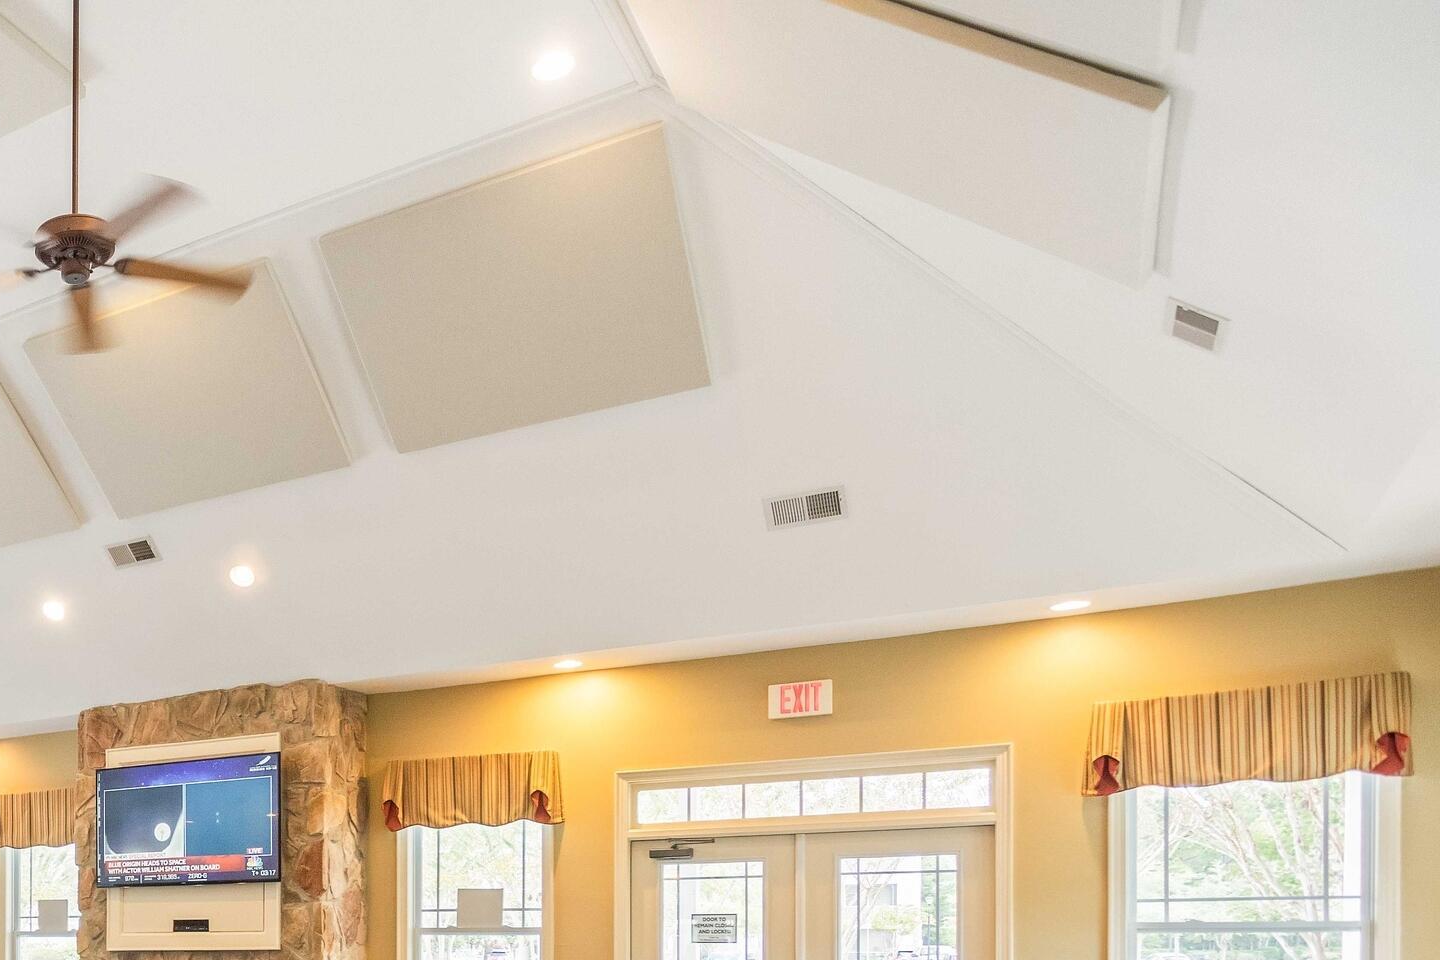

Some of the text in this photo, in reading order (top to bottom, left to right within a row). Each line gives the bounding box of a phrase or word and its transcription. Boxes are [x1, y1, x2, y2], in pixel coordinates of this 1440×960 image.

[780, 682, 822, 714] EXIT
[122, 860, 141, 868] ORIGIN
[141, 859, 160, 867] HEADS
[169, 858, 187, 866] SPACE
[200, 863, 220, 871] BOARD
